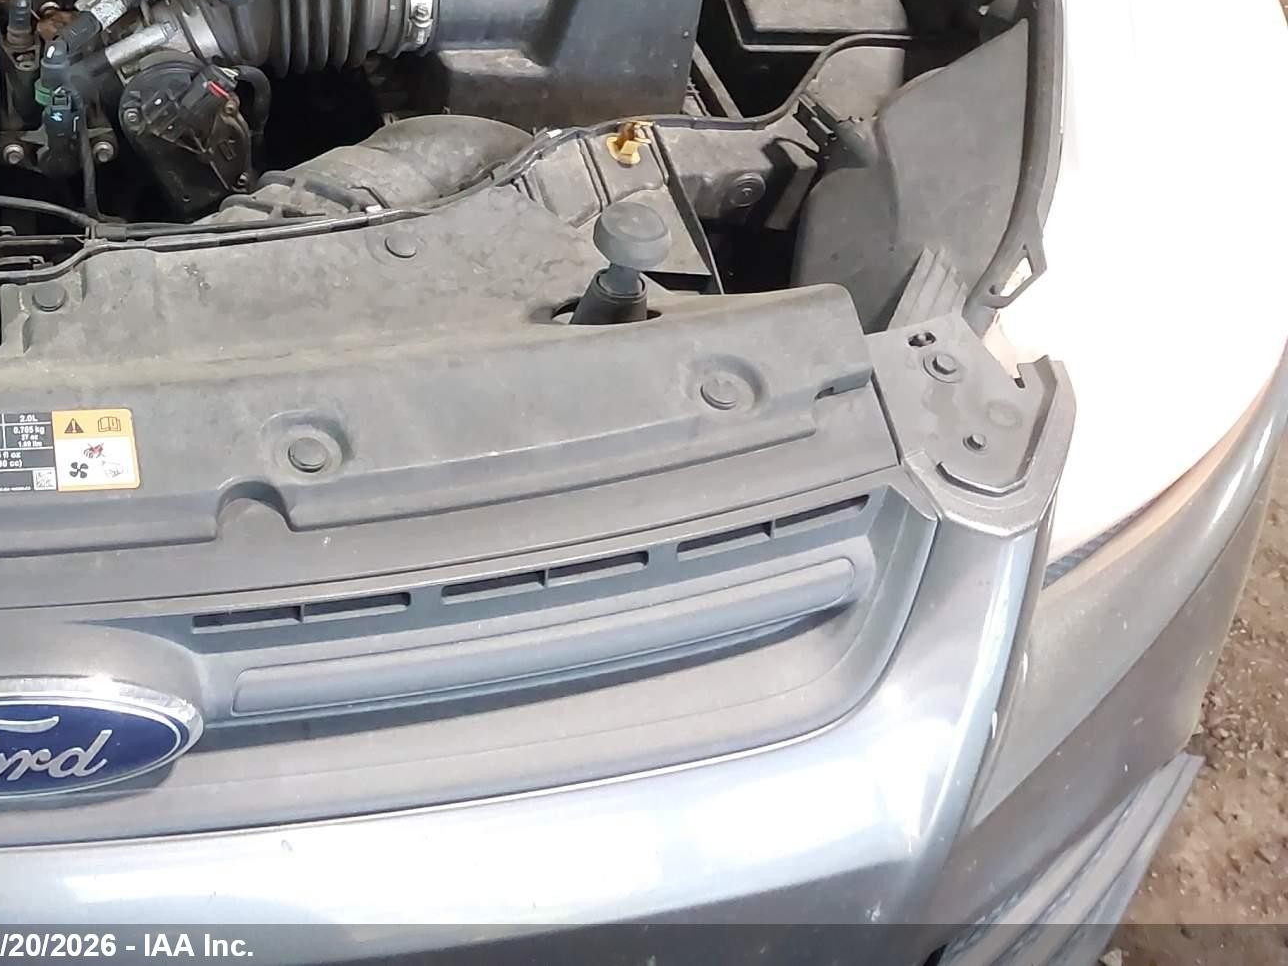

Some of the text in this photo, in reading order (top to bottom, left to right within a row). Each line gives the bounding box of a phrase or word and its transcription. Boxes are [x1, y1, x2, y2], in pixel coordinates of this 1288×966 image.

[19, 414, 38, 423] 2.0L
[34, 425, 45, 435] kg
[10, 451, 21, 459] oz
[9, 458, 23, 468] cc)
